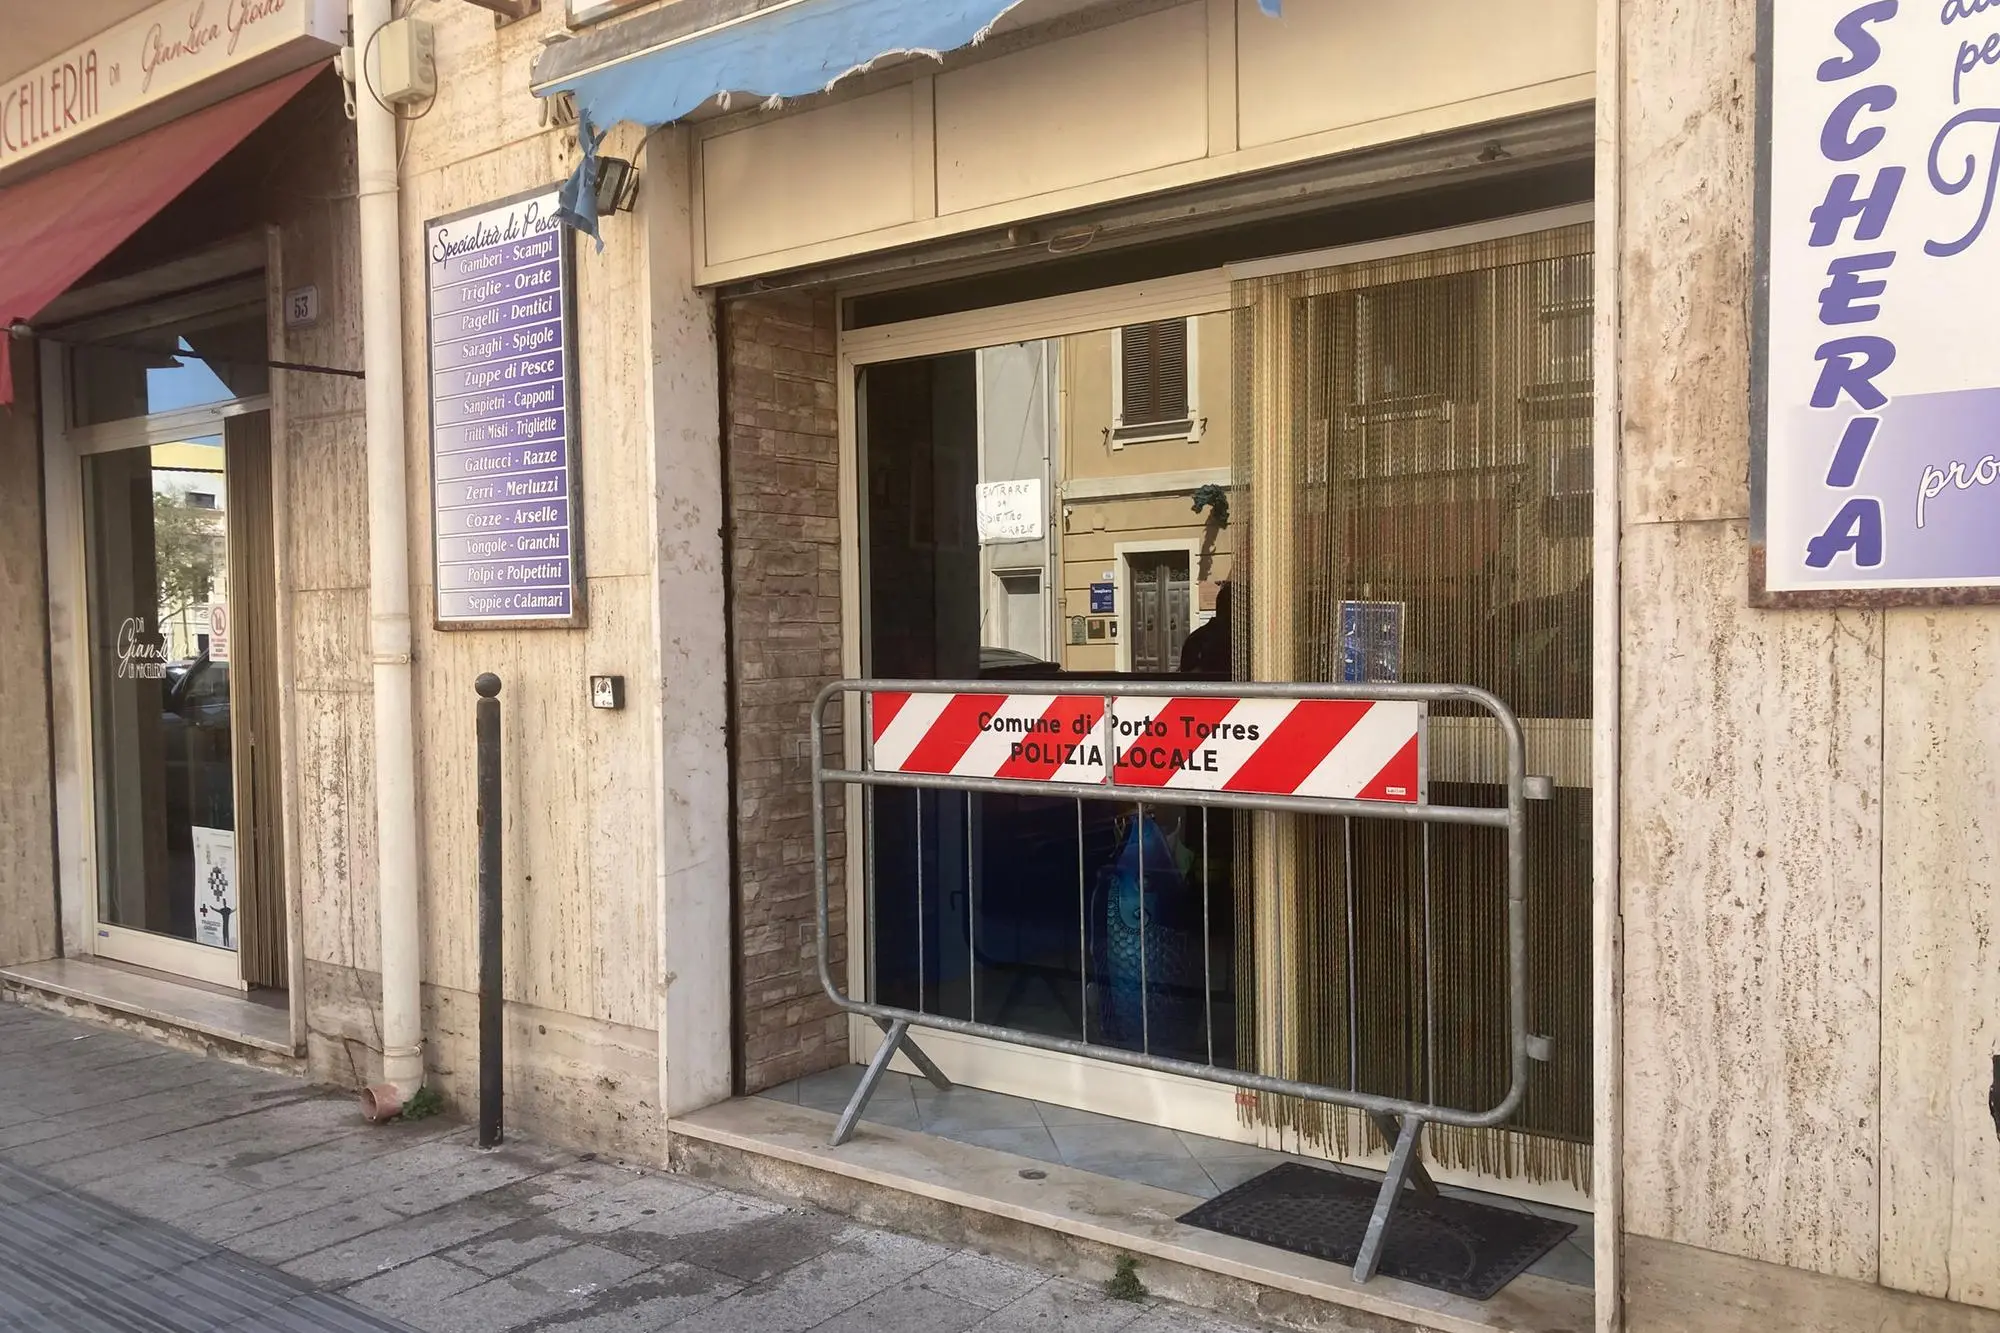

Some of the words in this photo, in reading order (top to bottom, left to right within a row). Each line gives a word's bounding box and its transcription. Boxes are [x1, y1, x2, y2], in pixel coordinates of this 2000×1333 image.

[0, 49, 98, 157] CELLERIA
[433, 221, 502, 269] Specialità
[503, 212, 520, 240] di
[522, 201, 560, 238] Pesce
[460, 249, 503, 273] Gamberi
[513, 235, 553, 261] Scampi
[461, 280, 501, 303] Triglie
[514, 269, 552, 289] Orate
[462, 308, 499, 331] Pagelli
[511, 296, 552, 319] Dentici
[462, 336, 502, 358] Saraghi
[513, 327, 554, 351] Spigole
[465, 369, 501, 388] Zuppe
[505, 362, 517, 379] di
[521, 359, 555, 376] Pesce
[464, 394, 505, 415] Sanpietri
[514, 385, 555, 409] Capponi
[465, 426, 485, 441] Fritti
[488, 422, 508, 439] Misti
[516, 416, 557, 438] Trigliette
[465, 452, 511, 472] Gattucci
[523, 450, 557, 465] Razze
[466, 483, 493, 500] Zerri
[506, 475, 558, 496] Merluzzi
[983, 483, 1029, 498] ENTRARE
[466, 513, 502, 528] Cozze
[514, 506, 558, 524] Arselle
[517, 533, 560, 551] Granchi
[468, 566, 494, 584] Polpi
[497, 569, 504, 580] e
[507, 562, 562, 583] Polpettini
[468, 594, 501, 612] Seppie
[504, 597, 511, 608] e
[514, 591, 563, 608] Calamari
[978, 711, 1060, 734] Comune
[1072, 714, 1092, 735] di
[1179, 716, 1260, 741] Torres
[1010, 742, 1103, 766] POLIZIA
[1115, 745, 1218, 772] LOCALE
